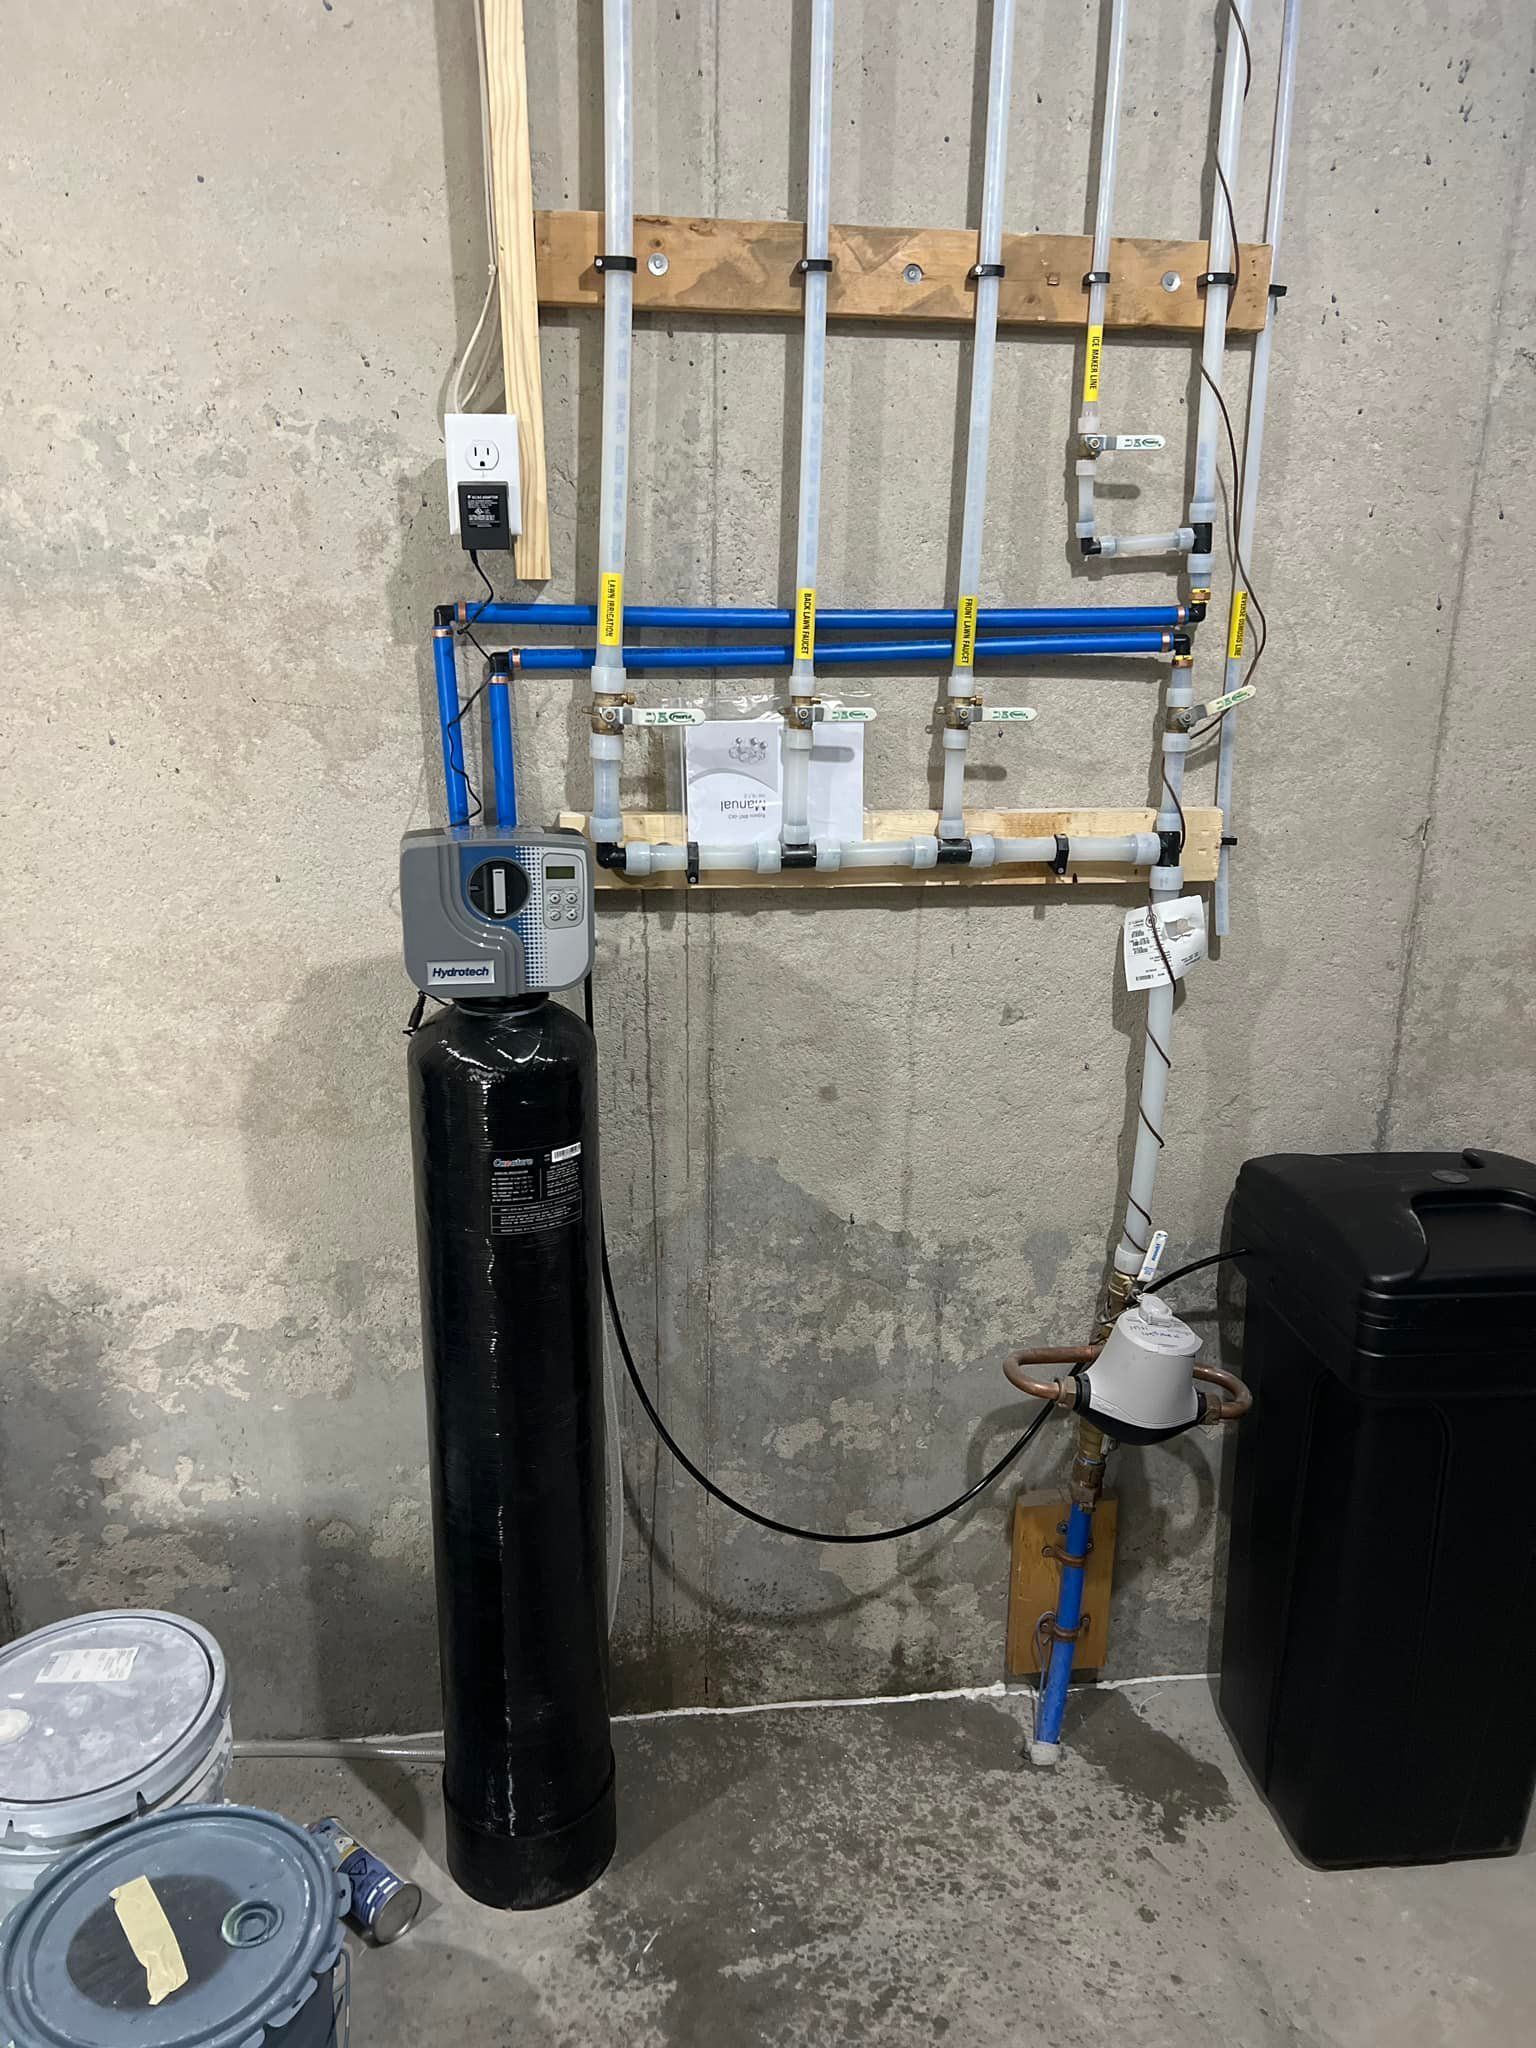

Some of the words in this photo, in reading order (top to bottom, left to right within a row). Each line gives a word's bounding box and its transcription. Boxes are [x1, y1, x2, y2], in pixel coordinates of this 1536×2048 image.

[1091, 336, 1100, 347] ICE
[1090, 349, 1099, 373] MAKER
[1089, 374, 1098, 390] LINE
[607, 579, 616, 599] LAWN
[803, 593, 812, 610] BACK
[964, 598, 973, 619] FRONT
[1238, 592, 1248, 618] REVERSE
[605, 600, 615, 637] IRRIGATION
[802, 612, 811, 630] LAWN
[962, 620, 972, 639] LAWN
[1236, 618, 1246, 643] OSMOSIS
[801, 631, 810, 654] FAUCET
[961, 640, 971, 664] FAUCET
[1233, 644, 1243, 656] LINE
[720, 800, 766, 812] Manual
[432, 966, 489, 978] Hydrotech
